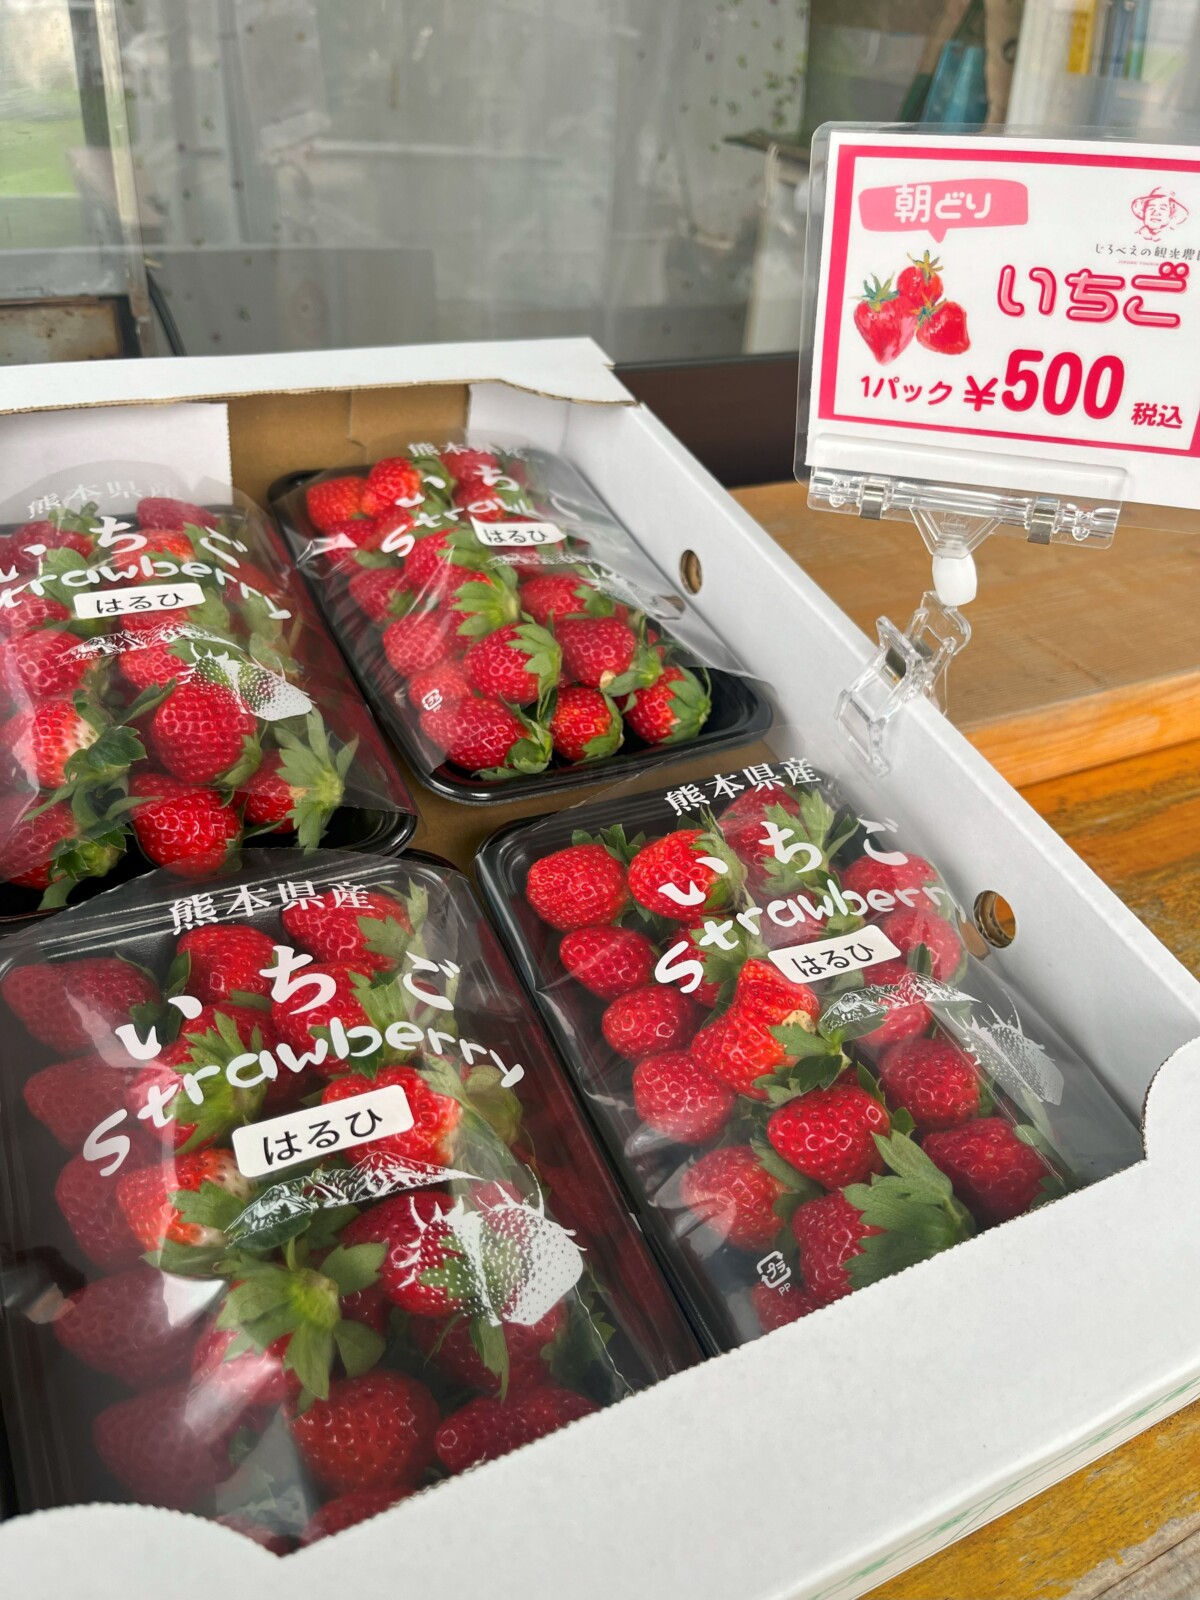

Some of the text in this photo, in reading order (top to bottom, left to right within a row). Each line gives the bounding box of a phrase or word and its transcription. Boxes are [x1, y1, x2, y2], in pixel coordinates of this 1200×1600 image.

[894, 183, 992, 224] 朝どり
[1095, 242, 1200, 261] じろべえの観光農
[997, 261, 1190, 330] いちご
[860, 348, 1184, 430] 1パック ¥500 税込
[484, 529, 548, 544] はるひ
[96, 592, 184, 614] はるひ
[664, 756, 822, 817] 熊本県産
[657, 816, 909, 907] いちご
[168, 880, 376, 935] 熊本県産
[791, 941, 874, 978] はるひ
[115, 944, 460, 1060] いちご
[83, 1017, 525, 1177] Strawberry
[262, 1107, 384, 1166] はるひ
[778, 1282, 791, 1297] PP
